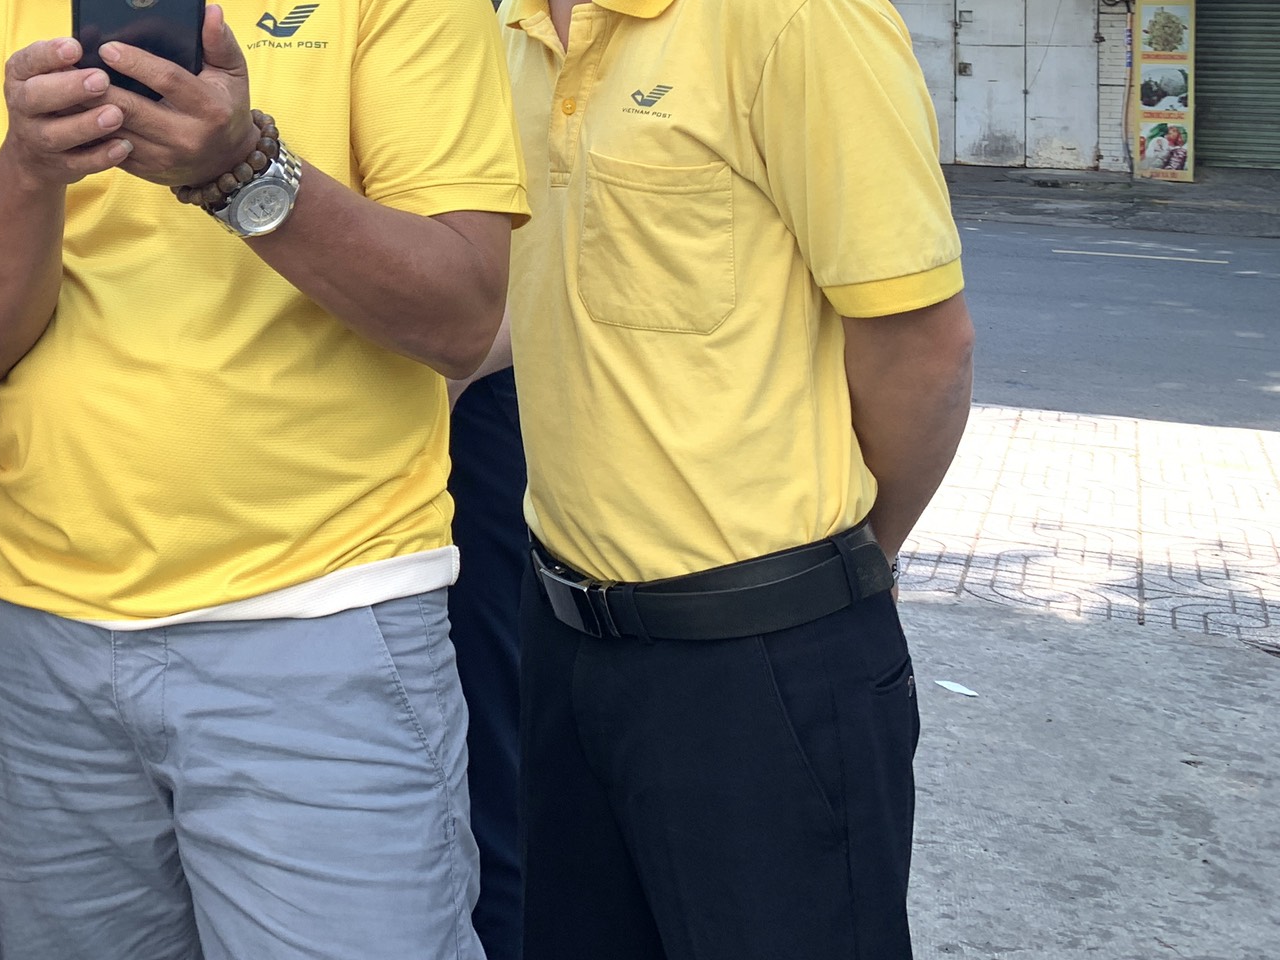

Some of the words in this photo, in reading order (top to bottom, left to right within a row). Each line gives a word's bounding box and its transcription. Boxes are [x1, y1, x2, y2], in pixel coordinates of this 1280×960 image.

[247, 39, 292, 50] VIETNAM
[297, 41, 329, 49] POST
[622, 107, 650, 115] VIETNAM
[652, 111, 672, 119] POST
